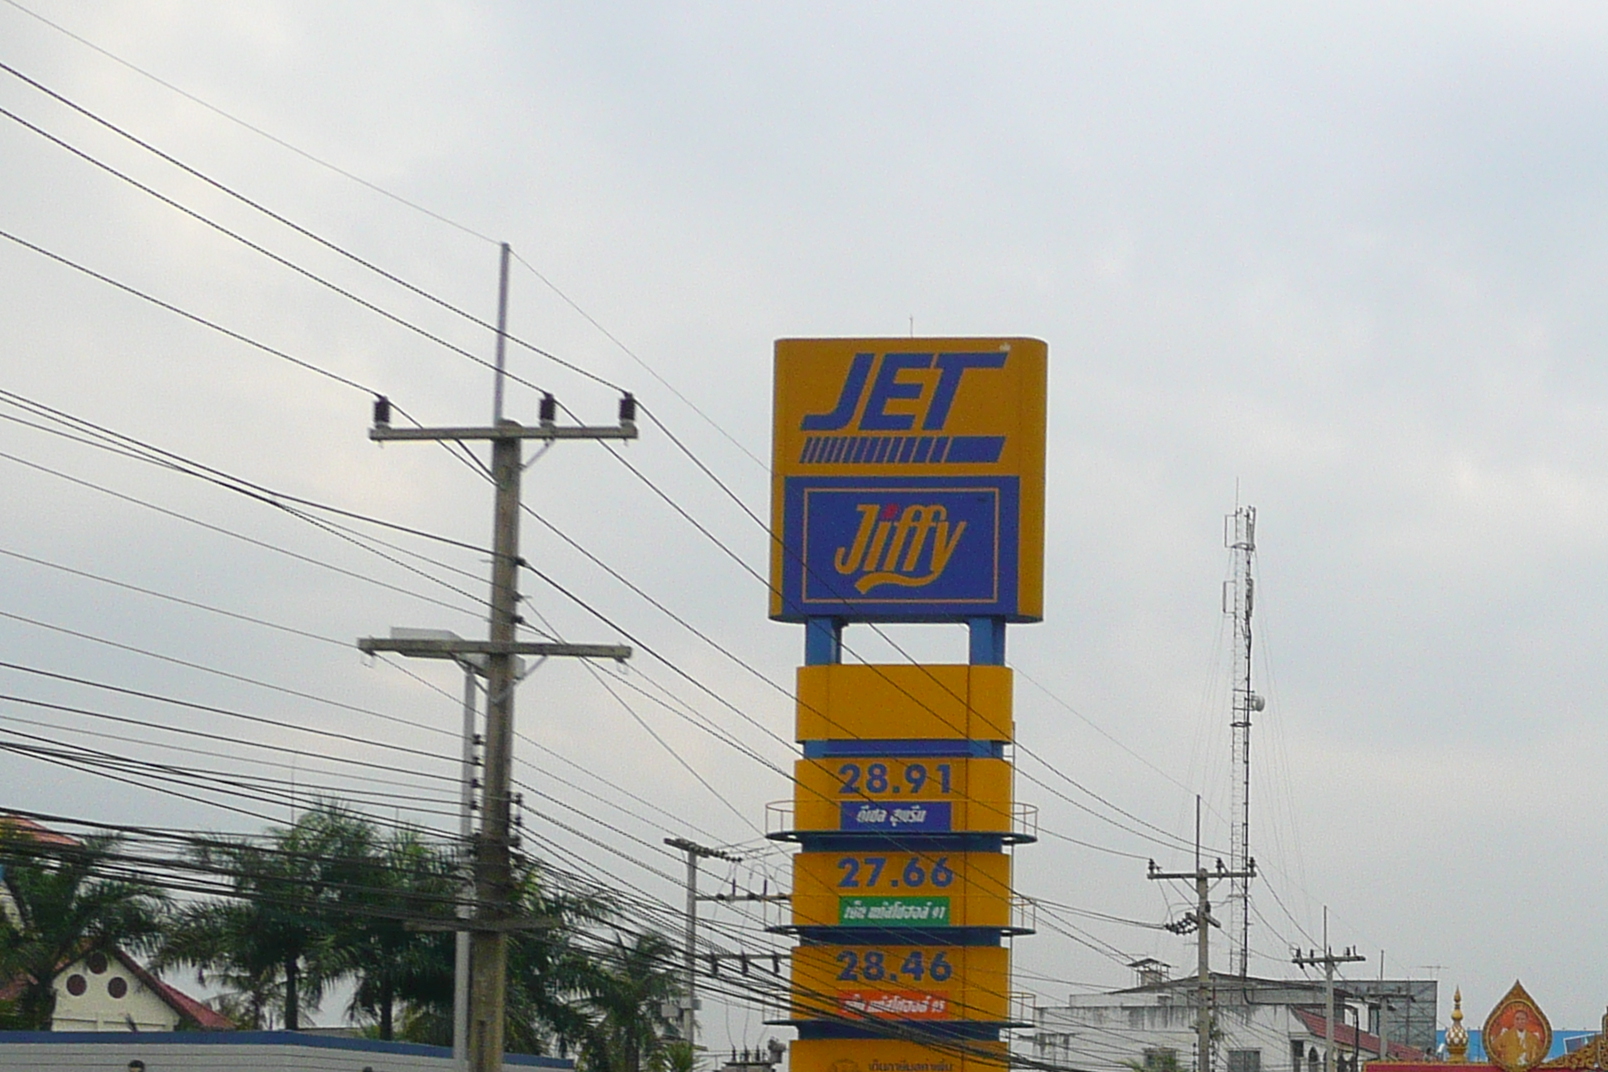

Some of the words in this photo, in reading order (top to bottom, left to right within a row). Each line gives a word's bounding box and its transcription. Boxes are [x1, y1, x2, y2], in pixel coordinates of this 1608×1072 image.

[799, 352, 1009, 431] JET
[834, 503, 967, 595] Jiffy
[838, 763, 951, 793] 28.91
[837, 856, 954, 888] 27.66
[836, 950, 952, 982] 28.46
